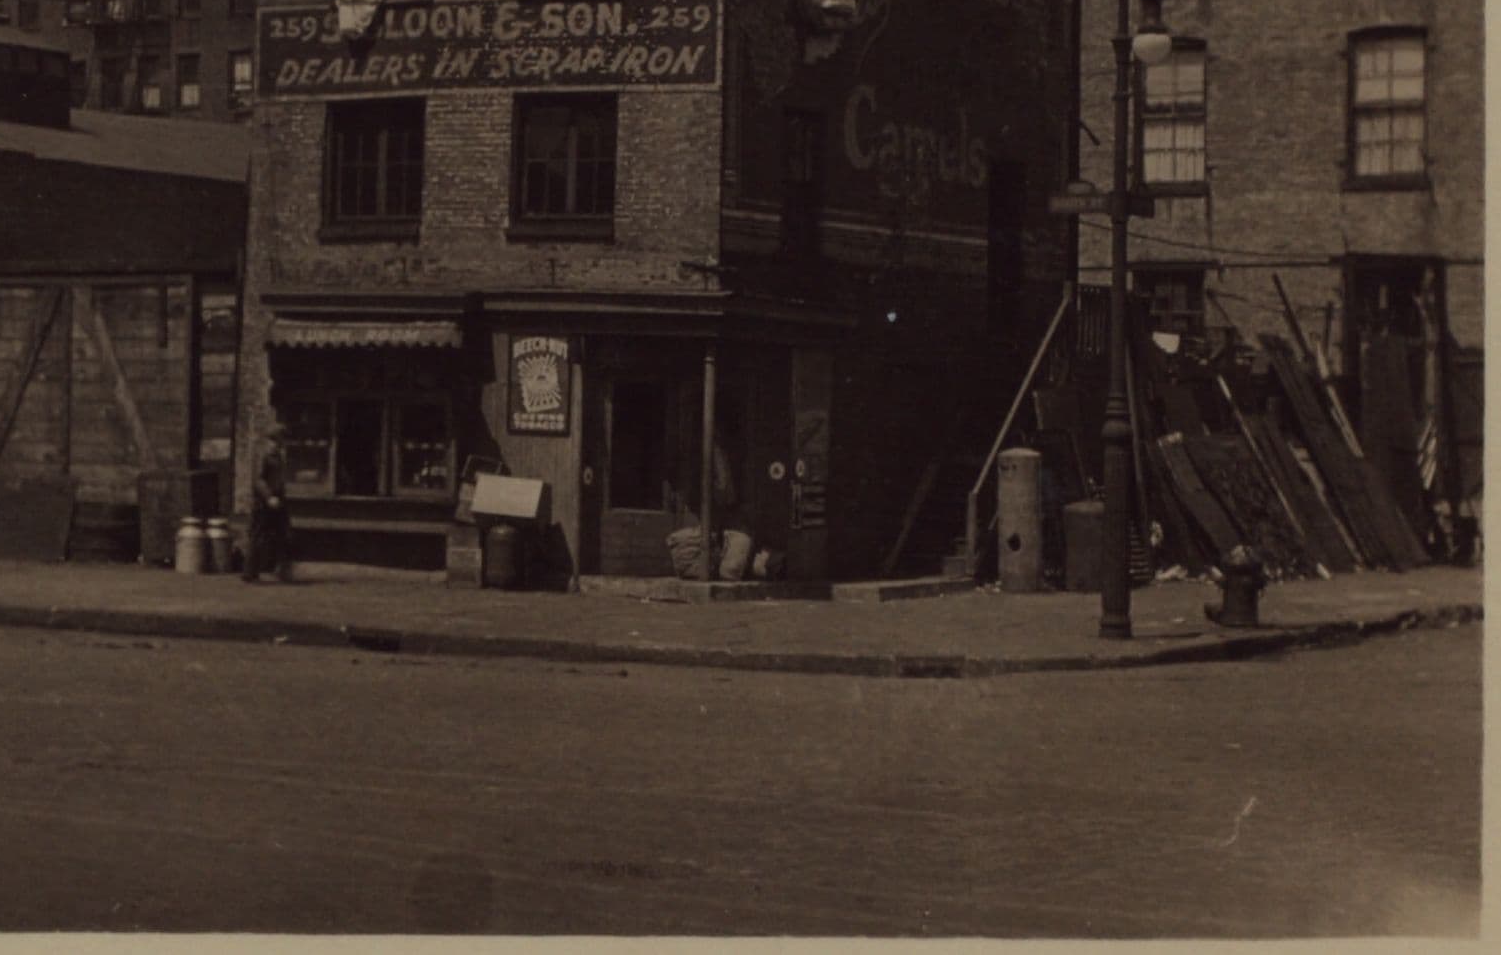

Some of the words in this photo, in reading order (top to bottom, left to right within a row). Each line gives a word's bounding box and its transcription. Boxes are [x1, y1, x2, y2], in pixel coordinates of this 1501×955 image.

[270, 16, 317, 42] 259
[376, 5, 482, 38] LOOM
[493, 2, 532, 41] &
[645, 5, 711, 33] 259
[276, 53, 425, 87] DEALERS
[432, 46, 482, 78] IN
[610, 45, 706, 78] IRON
